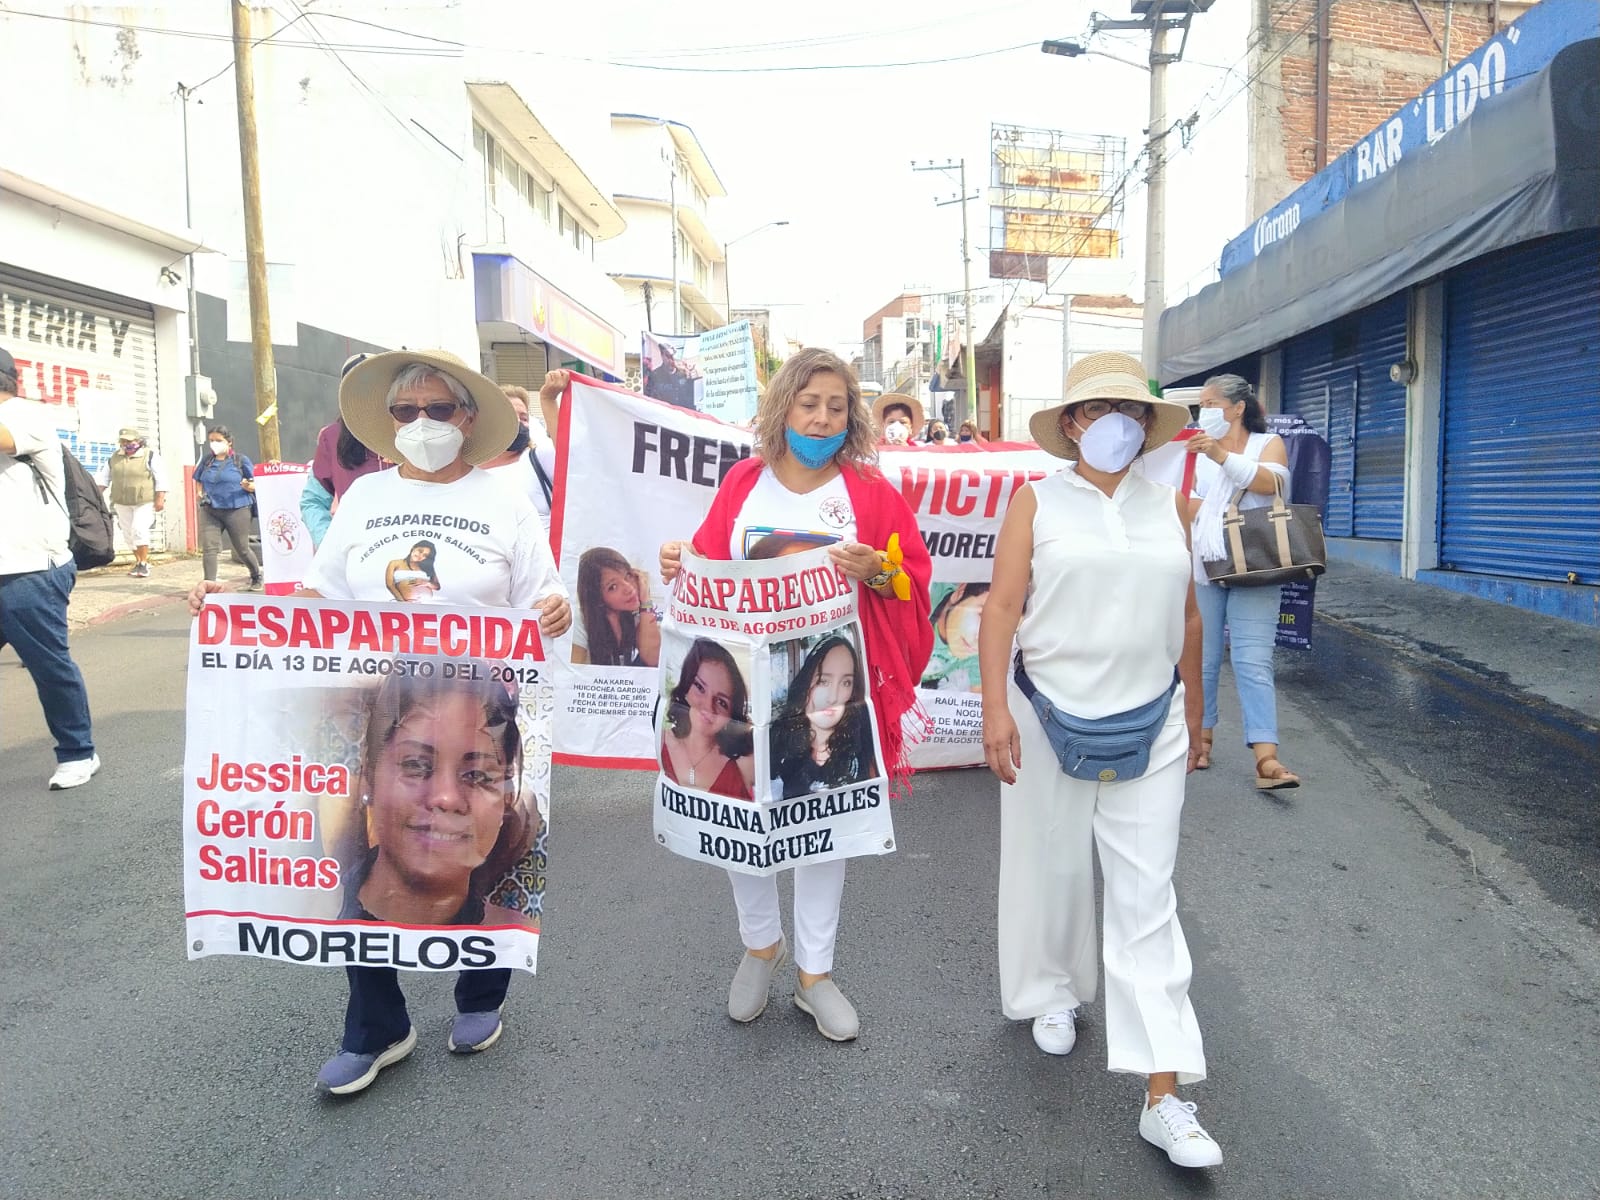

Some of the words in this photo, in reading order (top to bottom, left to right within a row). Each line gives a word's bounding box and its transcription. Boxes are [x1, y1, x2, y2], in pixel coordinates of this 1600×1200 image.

[1357, 117, 1403, 182] BAR
[1254, 203, 1300, 256] Corona
[899, 466, 1046, 518] VICTI
[365, 514, 491, 535] DESAPARECIDOS
[360, 534, 399, 563] JESSICA
[402, 530, 442, 540] CERON
[444, 536, 487, 565] SALINAS
[672, 562, 853, 613] DESAPARECIDA
[198, 603, 546, 663] DESAPARECIDA
[676, 610, 698, 625] DÍA
[702, 617, 717, 628] 12
[720, 618, 740, 632] DE
[743, 616, 807, 635] AGOSTO
[810, 612, 828, 625] DE
[202, 652, 227, 669] EL
[235, 650, 274, 670] DÍA
[282, 656, 305, 671] 13
[313, 657, 341, 673] DE
[347, 657, 434, 679] AGOSTO
[442, 664, 484, 680] DEL
[490, 665, 539, 684] 2012
[586, 692, 596, 700] DE
[935, 696, 959, 706] RAÚL
[938, 717, 951, 726] DE
[197, 753, 348, 796] Jessica
[197, 800, 312, 840] Cerón
[661, 782, 765, 834] VIRIDIANA
[769, 785, 880, 832] MORALES
[199, 845, 340, 889] Salinas
[699, 828, 834, 868] RODRÍGUEZ
[238, 922, 496, 969] MORELOS
